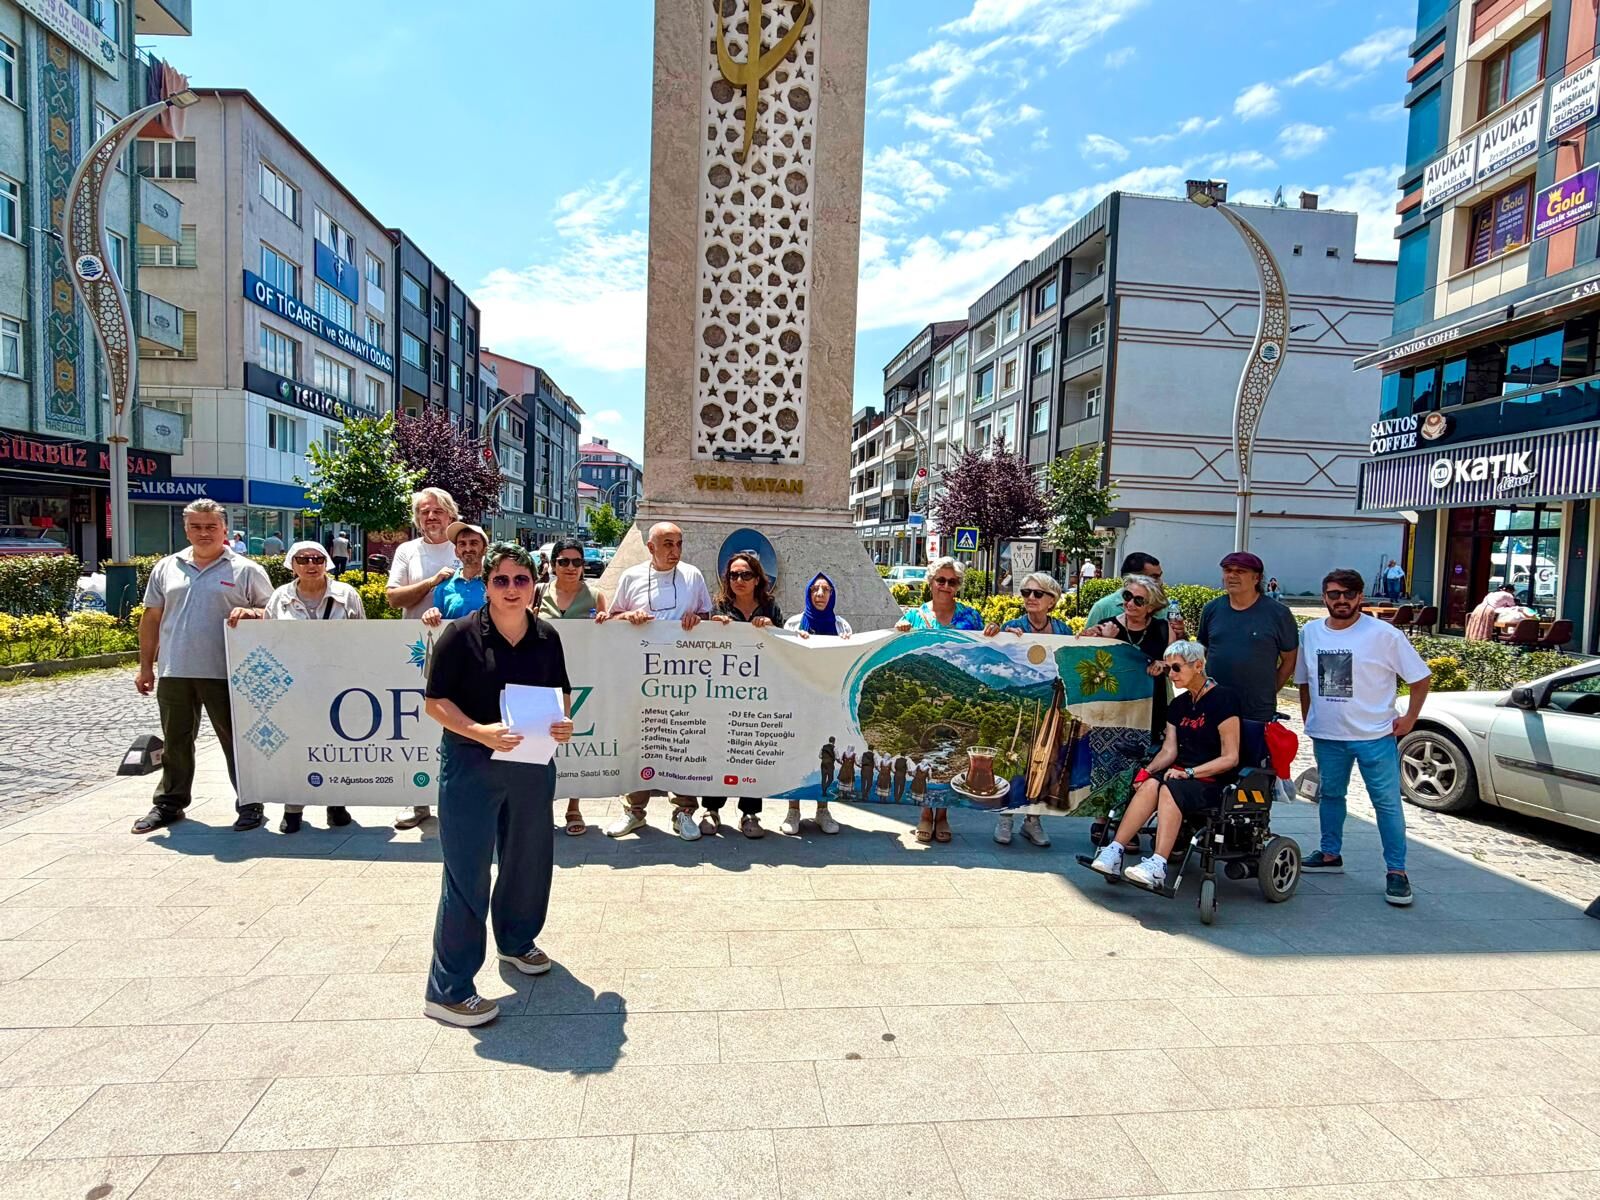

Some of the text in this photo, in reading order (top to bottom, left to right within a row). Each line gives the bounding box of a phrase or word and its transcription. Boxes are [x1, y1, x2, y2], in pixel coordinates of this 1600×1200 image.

[1559, 65, 1594, 93] HUKUK
[1553, 80, 1596, 113] DANIŞMANLIK
[1554, 96, 1592, 123] BÜROSU
[1482, 103, 1538, 153] AVUKAT
[1427, 143, 1473, 186] AVUKAT
[1501, 194, 1523, 213] Gold
[1547, 187, 1586, 217] Gold
[1536, 212, 1566, 231] GÜZELLİK
[1566, 201, 1594, 219] SALONU
[256, 281, 274, 305] OF
[276, 293, 324, 334] TİCARET
[325, 326, 337, 341] ve
[338, 329, 369, 359] SANAYİ
[1394, 328, 1460, 358] SANTOS COFFEE
[1371, 414, 1418, 438] SANTOS
[1370, 432, 1417, 454] COFFEE
[0, 435, 157, 476] GÜRBÜZ KSAP
[131, 481, 207, 495] ALKBANK
[693, 474, 804, 495] TEK VATAN
[675, 640, 732, 651] SANATÇILAR
[643, 652, 760, 678] Emre Fel
[641, 674, 769, 705] Grup İmera
[644, 708, 690, 718] Mesut Çakır
[644, 717, 707, 726] Peradi Ensemble
[731, 710, 793, 719] DJ Efe Can Saral
[644, 725, 706, 737] Seyfettin Çakıral
[730, 729, 796, 739] Turan Topçuoğlu
[731, 720, 784, 729] Dursun Dereli
[644, 734, 690, 745] Fadime Hala
[644, 743, 688, 754] Semih Saral
[730, 738, 778, 748] Bilgin Akyüz
[307, 743, 394, 763] KÜLTÜR
[400, 746, 430, 762] VE
[664, 753, 682, 763] Eşref
[684, 755, 707, 763] Abdik
[729, 747, 785, 757] Necati Cevahir
[729, 755, 776, 766] Önder Gider
[340, 775, 374, 786] Ağustos
[376, 776, 394, 784] 2026
[557, 770, 579, 779] şlama
[602, 769, 620, 777] 16:00
